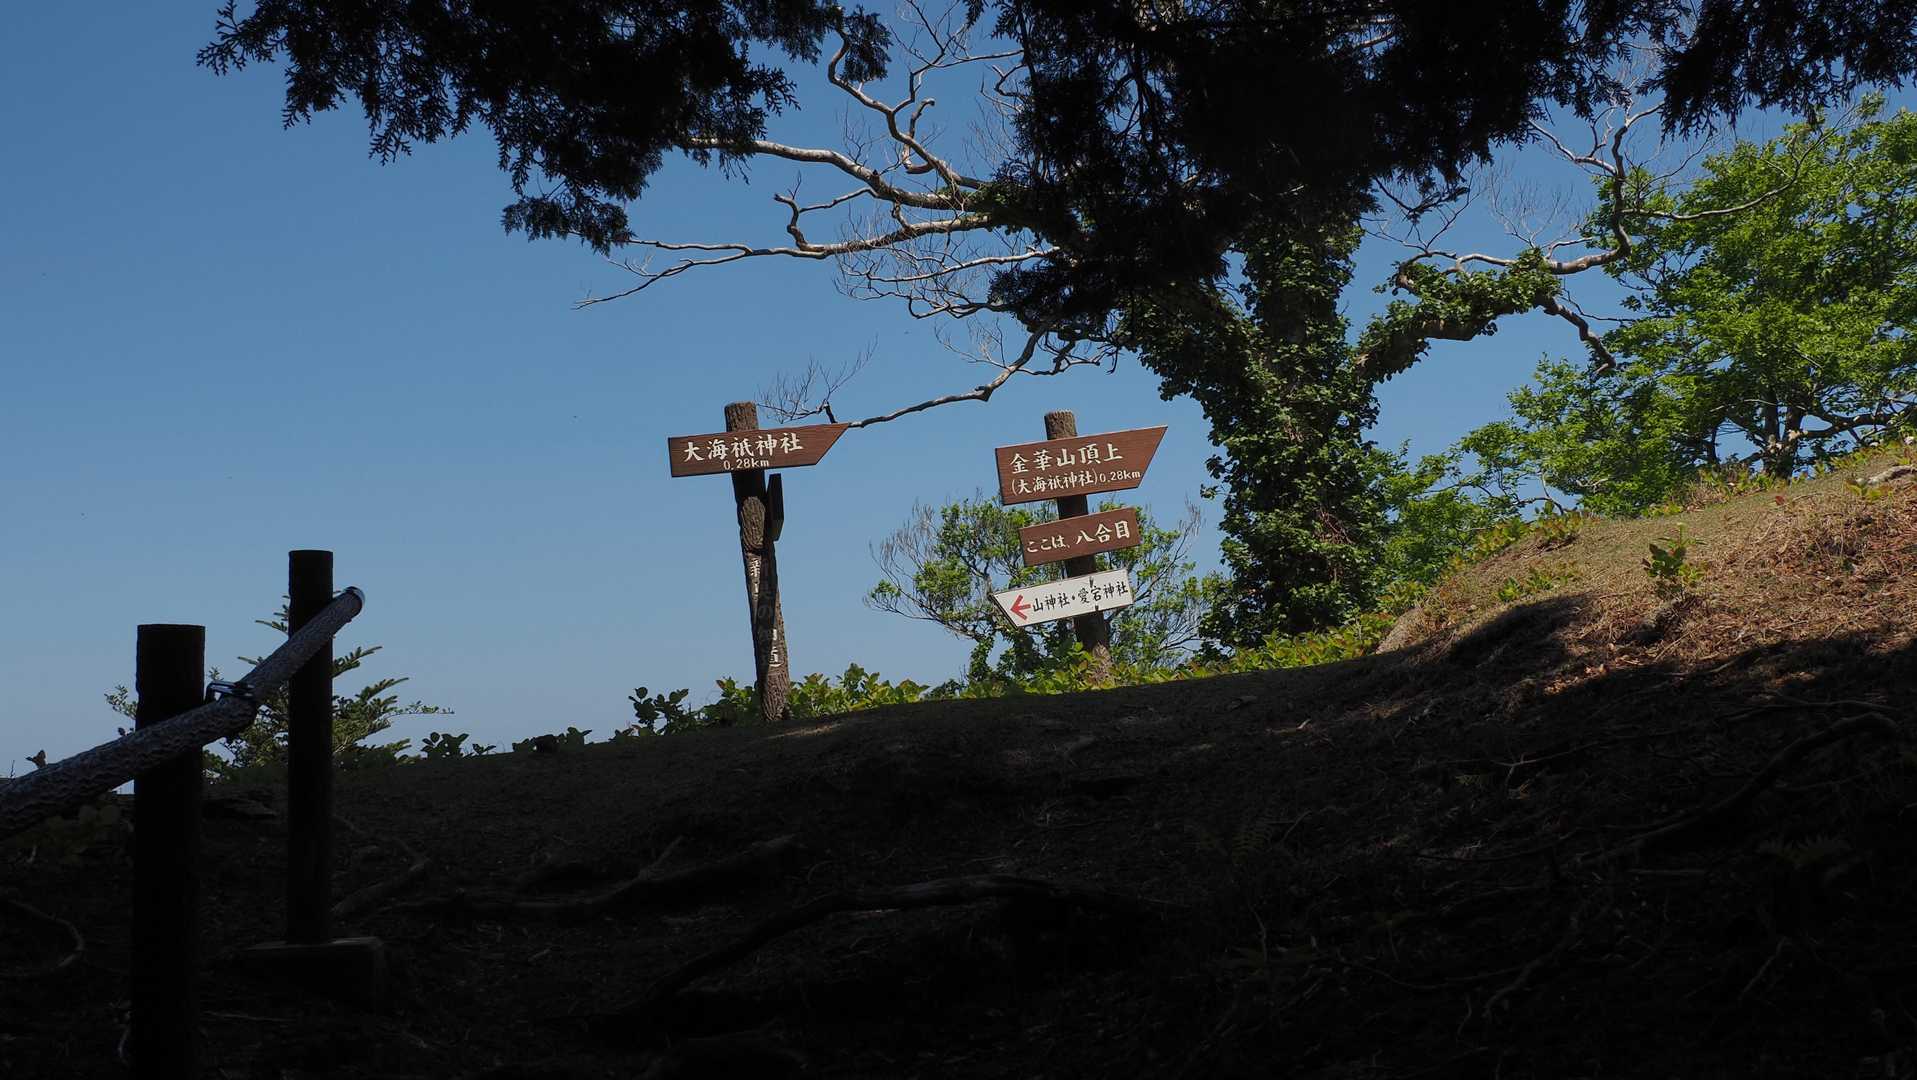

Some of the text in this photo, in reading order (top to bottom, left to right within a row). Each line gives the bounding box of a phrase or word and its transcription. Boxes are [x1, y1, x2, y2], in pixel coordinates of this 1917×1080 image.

[723, 457, 770, 470] 0.28km
[1009, 442, 1123, 475] 金華山頂上
